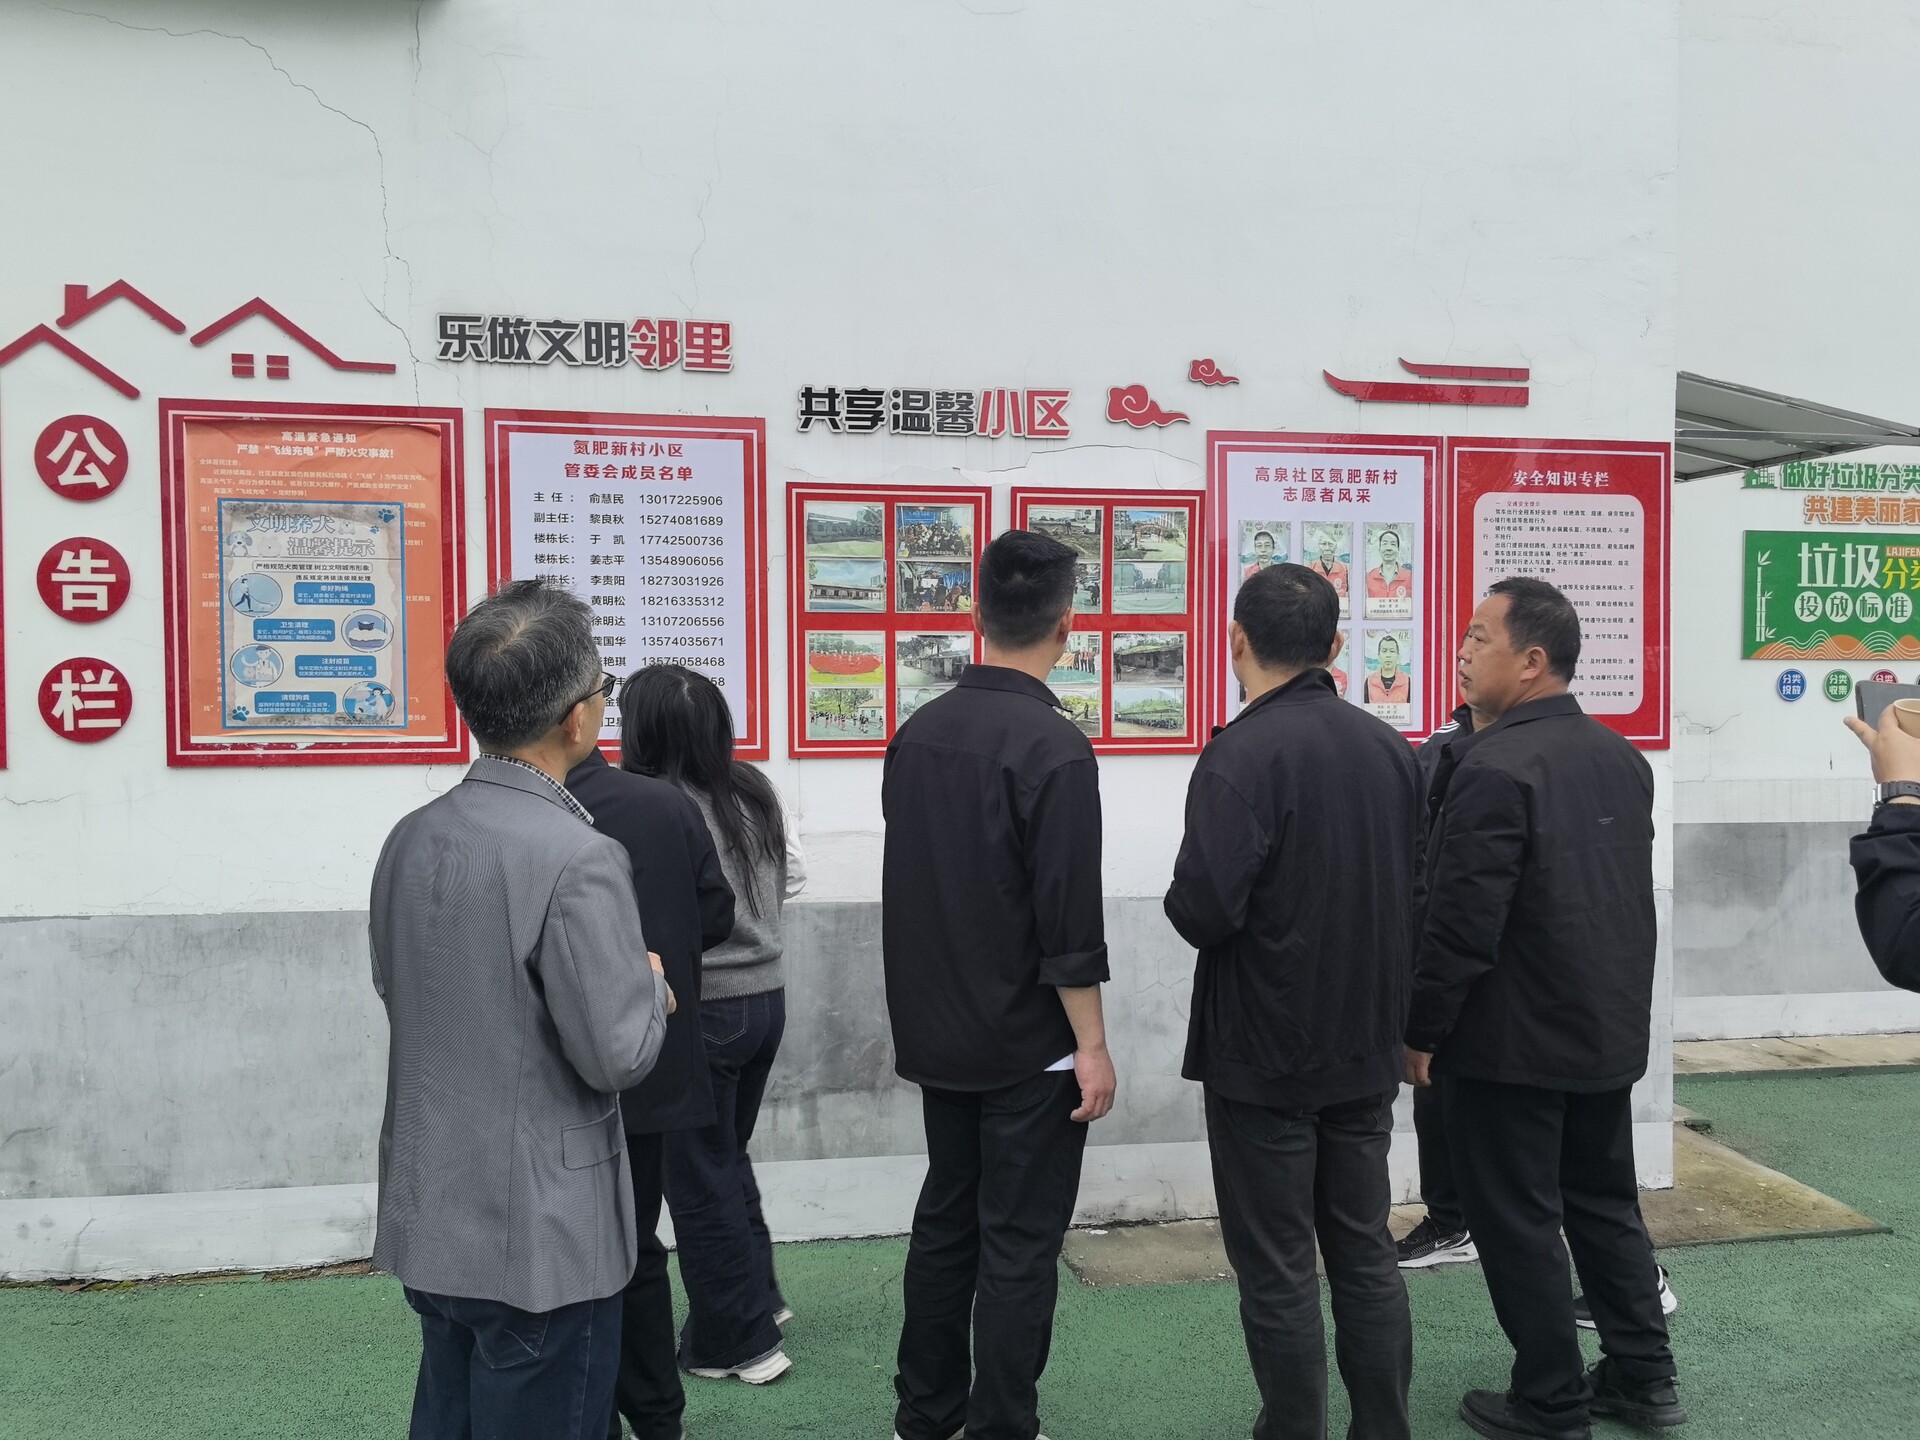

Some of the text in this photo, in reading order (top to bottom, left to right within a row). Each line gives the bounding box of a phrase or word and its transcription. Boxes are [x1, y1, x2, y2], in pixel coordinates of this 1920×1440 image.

[437, 315, 733, 373] 乐做文明邻里
[799, 385, 1071, 439] 共享温馨小区
[281, 431, 356, 443] 高温紧急通知
[573, 439, 684, 458] 氮肥新村小区
[564, 463, 693, 482] 管委会成员名单
[1255, 467, 1399, 484] 高泉社区氮肥新村
[1513, 470, 1609, 487] 安全知识专栏
[589, 492, 624, 505] 俞慧民
[639, 494, 723, 506] 13017225906
[1283, 488, 1371, 503] 志愿者风采
[246, 513, 336, 534] 文明养犬
[533, 512, 723, 526] 副主任： 黎良秋 15274081689
[534, 532, 575, 544] 楼栋长：
[639, 535, 724, 546] 17742500736
[287, 537, 376, 557] 温馨提示
[534, 553, 724, 567] 楼栋长： 姜志平 13548906056
[1797, 542, 1881, 588] 垃圾
[47, 427, 122, 732] 公告栏
[590, 575, 625, 586] 李贵阳
[640, 576, 724, 586] 18273031926
[591, 595, 724, 606] 黄明松 18216335312
[1799, 595, 1909, 618] 投放标准
[591, 616, 725, 627] 徐明达 13107206556
[641, 637, 724, 647] 13574035671
[321, 657, 350, 665] 注射疫苗
[600, 656, 725, 667] 艳琪 13575058468
[1783, 674, 1801, 684] 分类
[1829, 675, 1847, 684] 分类
[1783, 685, 1801, 694] 投放
[1829, 685, 1847, 695] 收集
